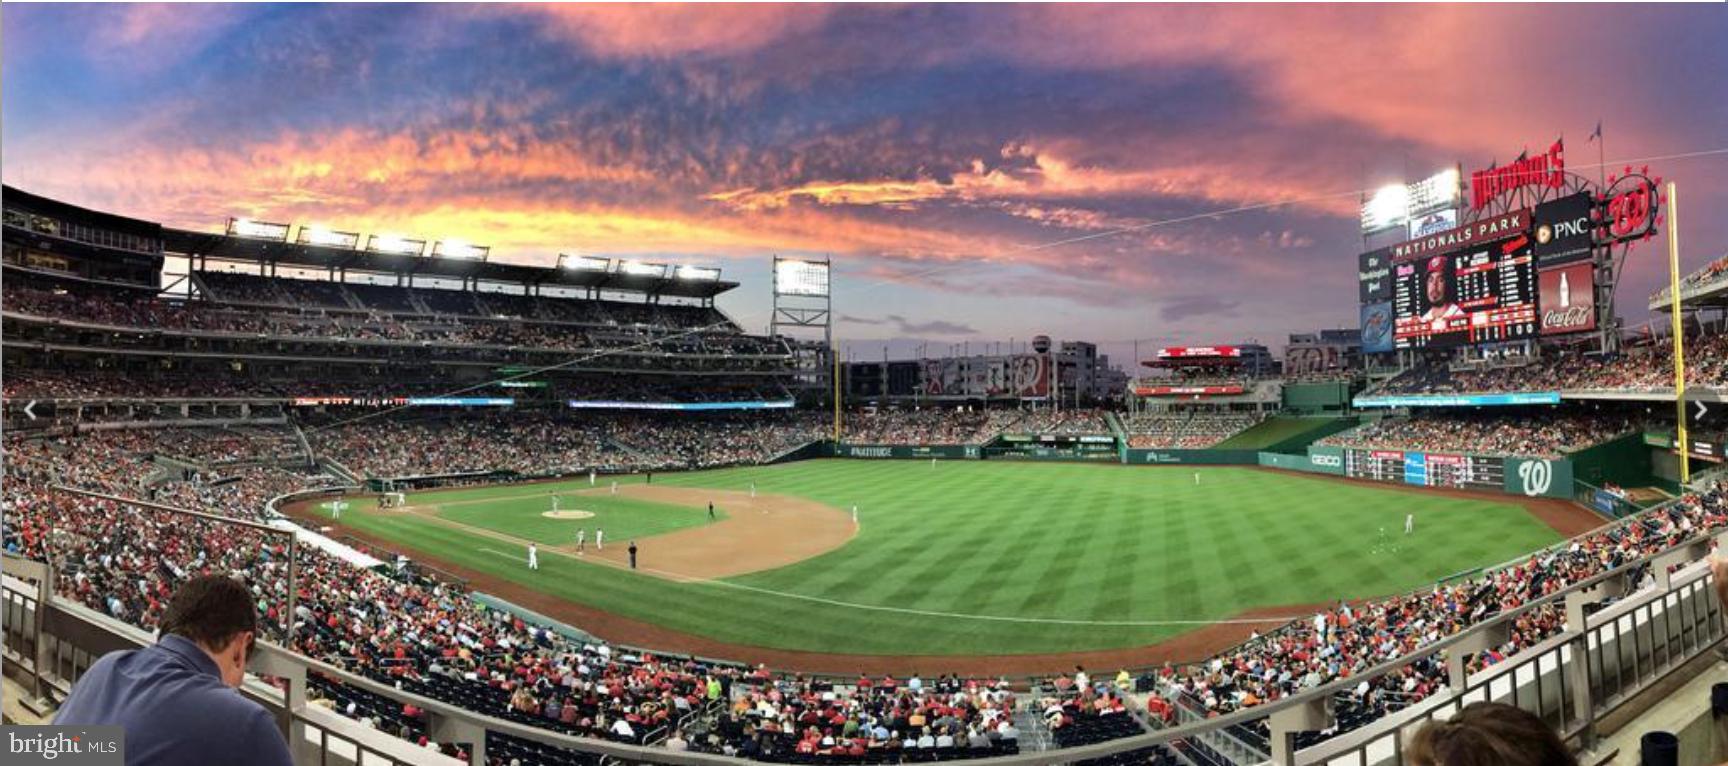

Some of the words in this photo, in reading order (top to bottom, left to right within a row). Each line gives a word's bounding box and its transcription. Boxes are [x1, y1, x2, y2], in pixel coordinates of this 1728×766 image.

[1396, 228, 1473, 258] NATIONALS
[1479, 216, 1521, 236] PARK
[1554, 217, 1589, 240] PNC
[1311, 456, 1341, 467] GEICO
[1519, 459, 1552, 496] W
